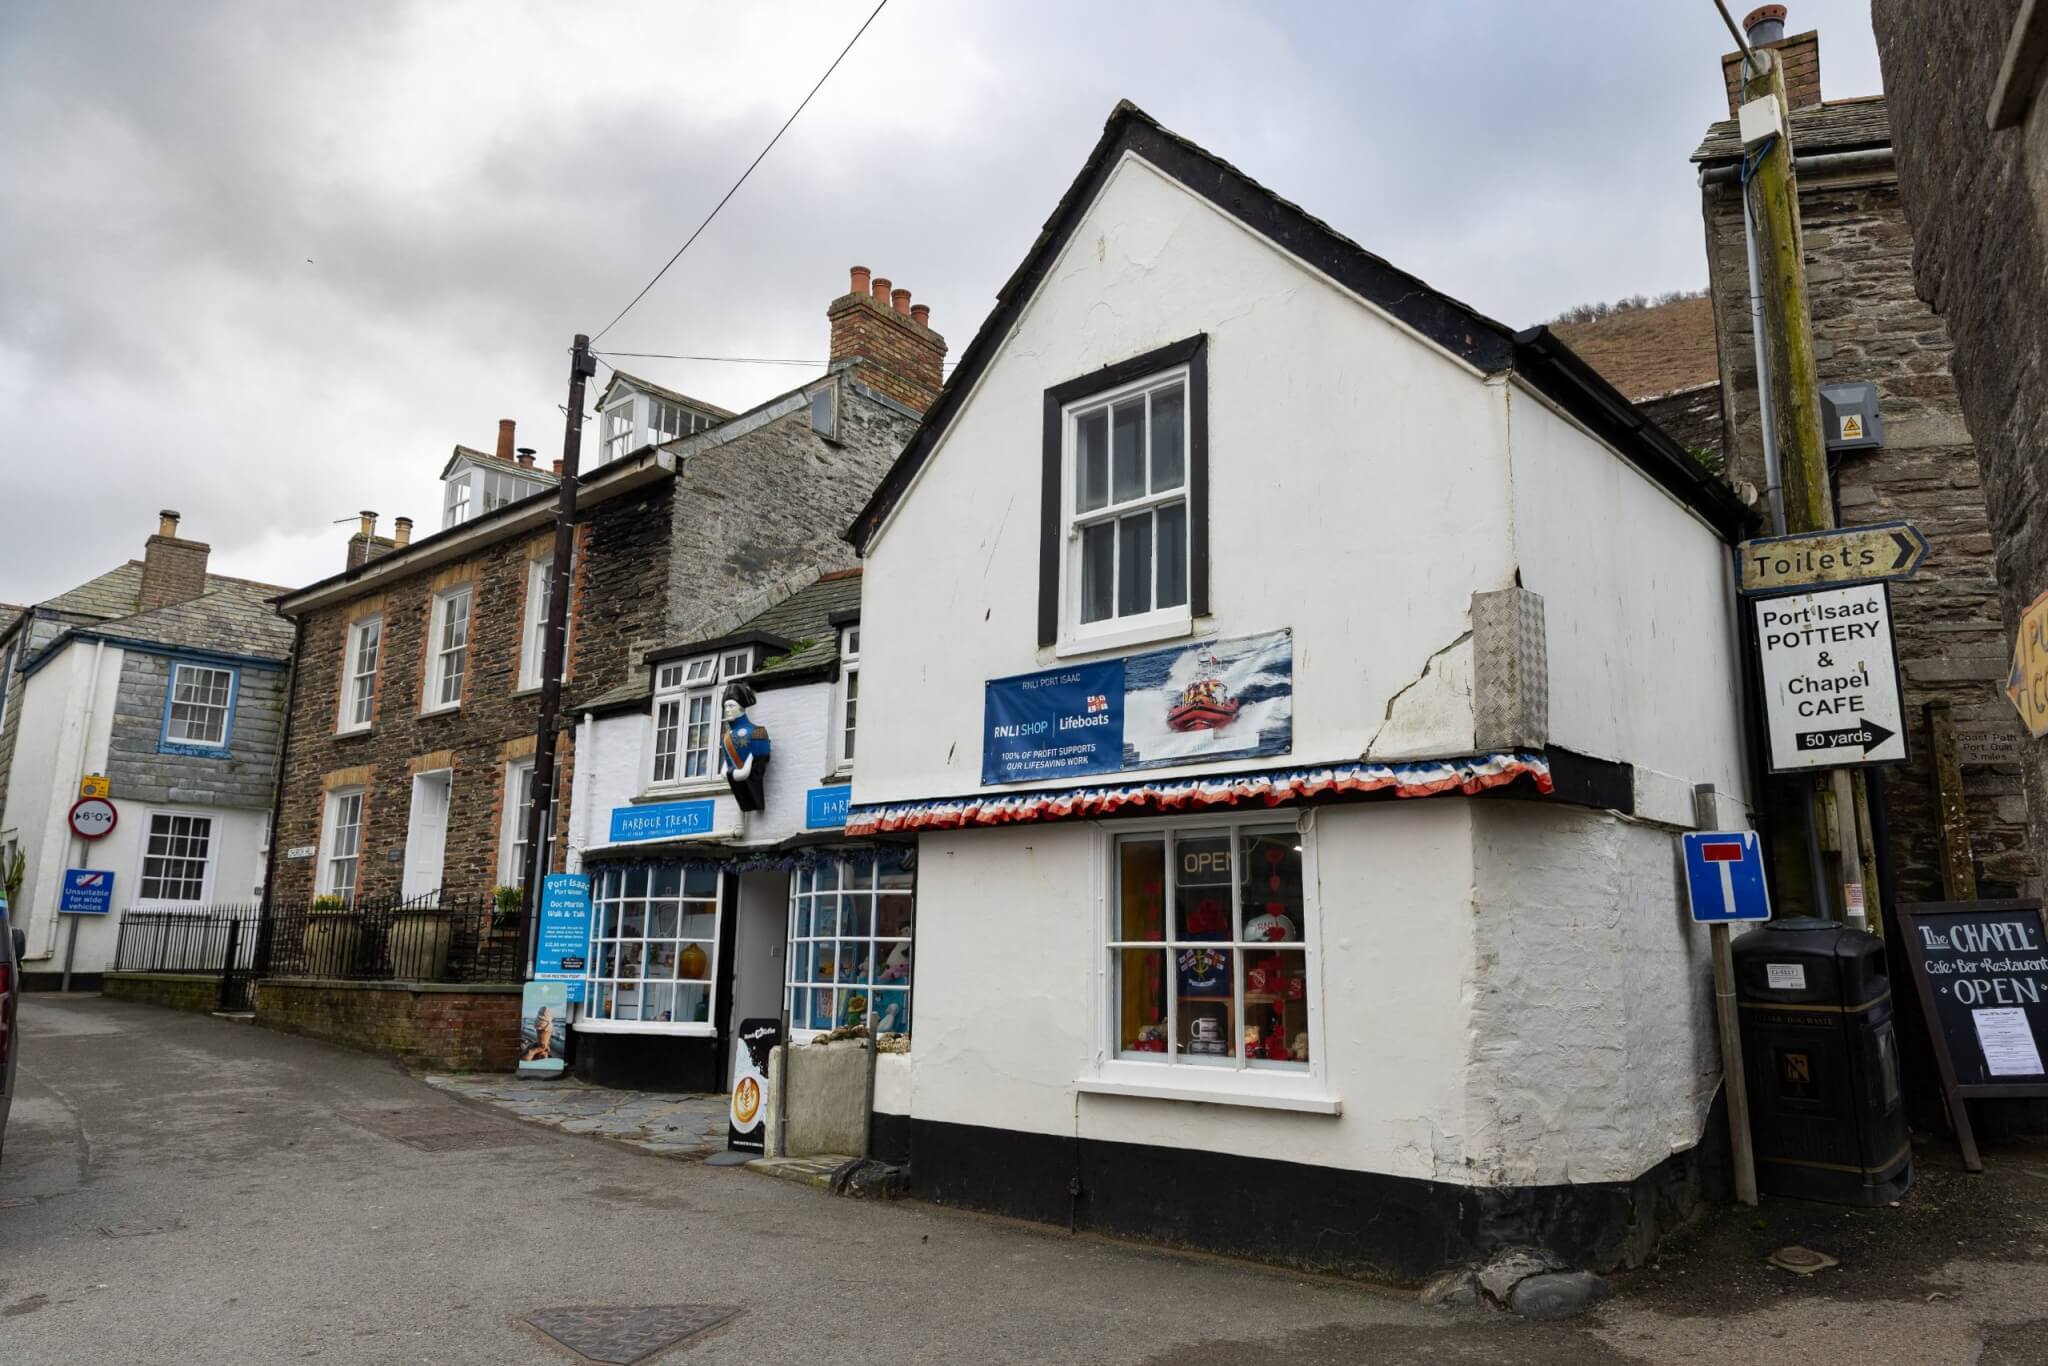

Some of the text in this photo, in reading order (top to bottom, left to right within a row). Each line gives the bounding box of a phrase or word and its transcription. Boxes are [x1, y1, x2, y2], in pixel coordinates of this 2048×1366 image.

[1753, 547, 1875, 577] Toilets
[1763, 600, 1880, 628] Port Isaac
[1766, 620, 1880, 651] POTTERY
[1817, 651, 1834, 668] &
[1022, 673, 1081, 690] RNLI PORT ISAAC
[1787, 670, 1869, 694] Chapel
[1798, 695, 1865, 717] CAFE
[994, 713, 1110, 739] RNLI SHOP Lifeboats
[1806, 729, 1873, 748] 50 yards
[1002, 743, 1096, 760] 100% OF PROFIT SUPPORTS
[1006, 756, 1089, 771] OUR LIFESAVING WORK
[622, 813, 699, 831] HARBOUR TREATS
[65, 888, 109, 896] Unsuitable
[547, 878, 590, 891] Port Isaac
[69, 903, 102, 911] vehicles
[70, 895, 103, 904] for wide
[550, 900, 563, 908] Doc
[1918, 921, 2039, 953] The CHAPEL
[1924, 956, 2048, 974] Cafe Bar Restaurant
[1953, 977, 2041, 1005] OPEN
